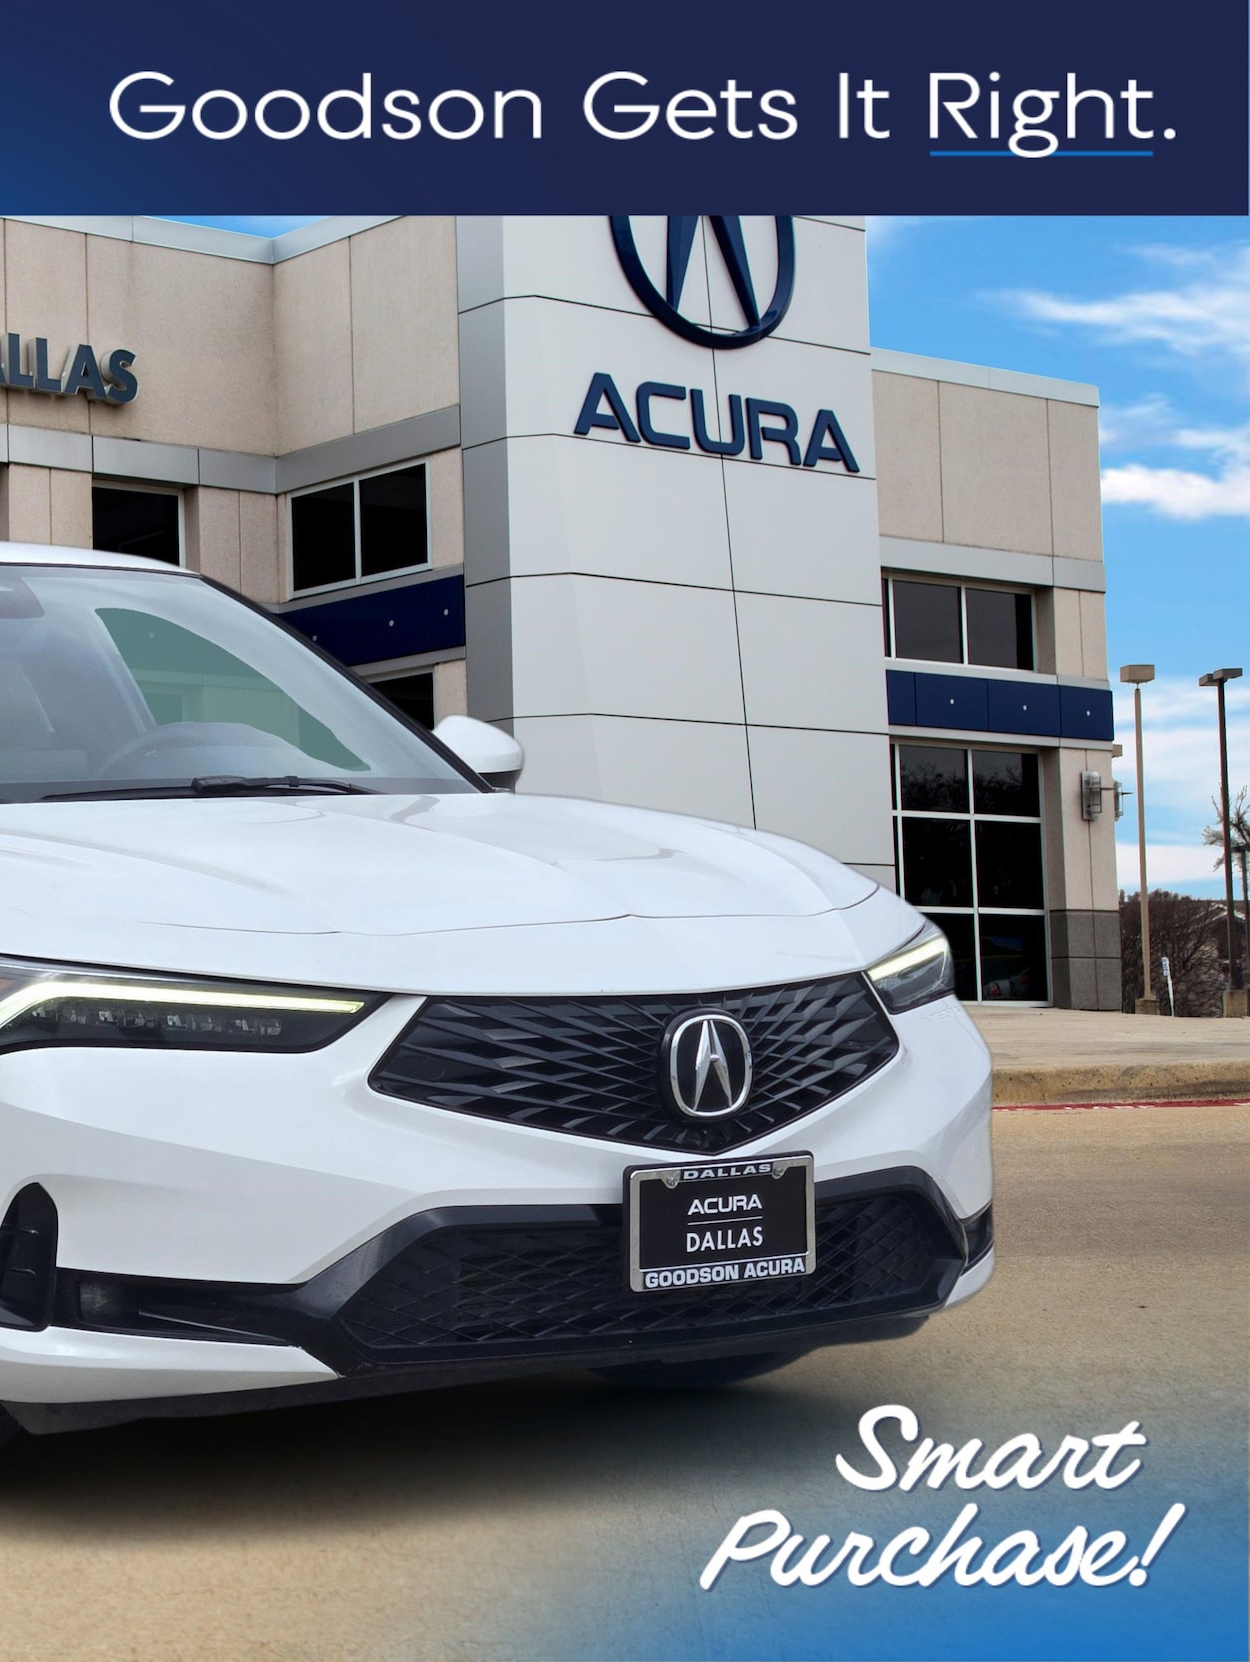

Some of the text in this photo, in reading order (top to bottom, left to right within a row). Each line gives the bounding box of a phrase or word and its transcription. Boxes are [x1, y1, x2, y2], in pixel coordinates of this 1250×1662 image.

[573, 372, 860, 473] ACURA
[683, 1163, 772, 1180] DALLAS
[687, 1193, 763, 1216] ACURA
[686, 1226, 764, 1253] DALLAS
[644, 1258, 805, 1289] GOODSON ACURA
